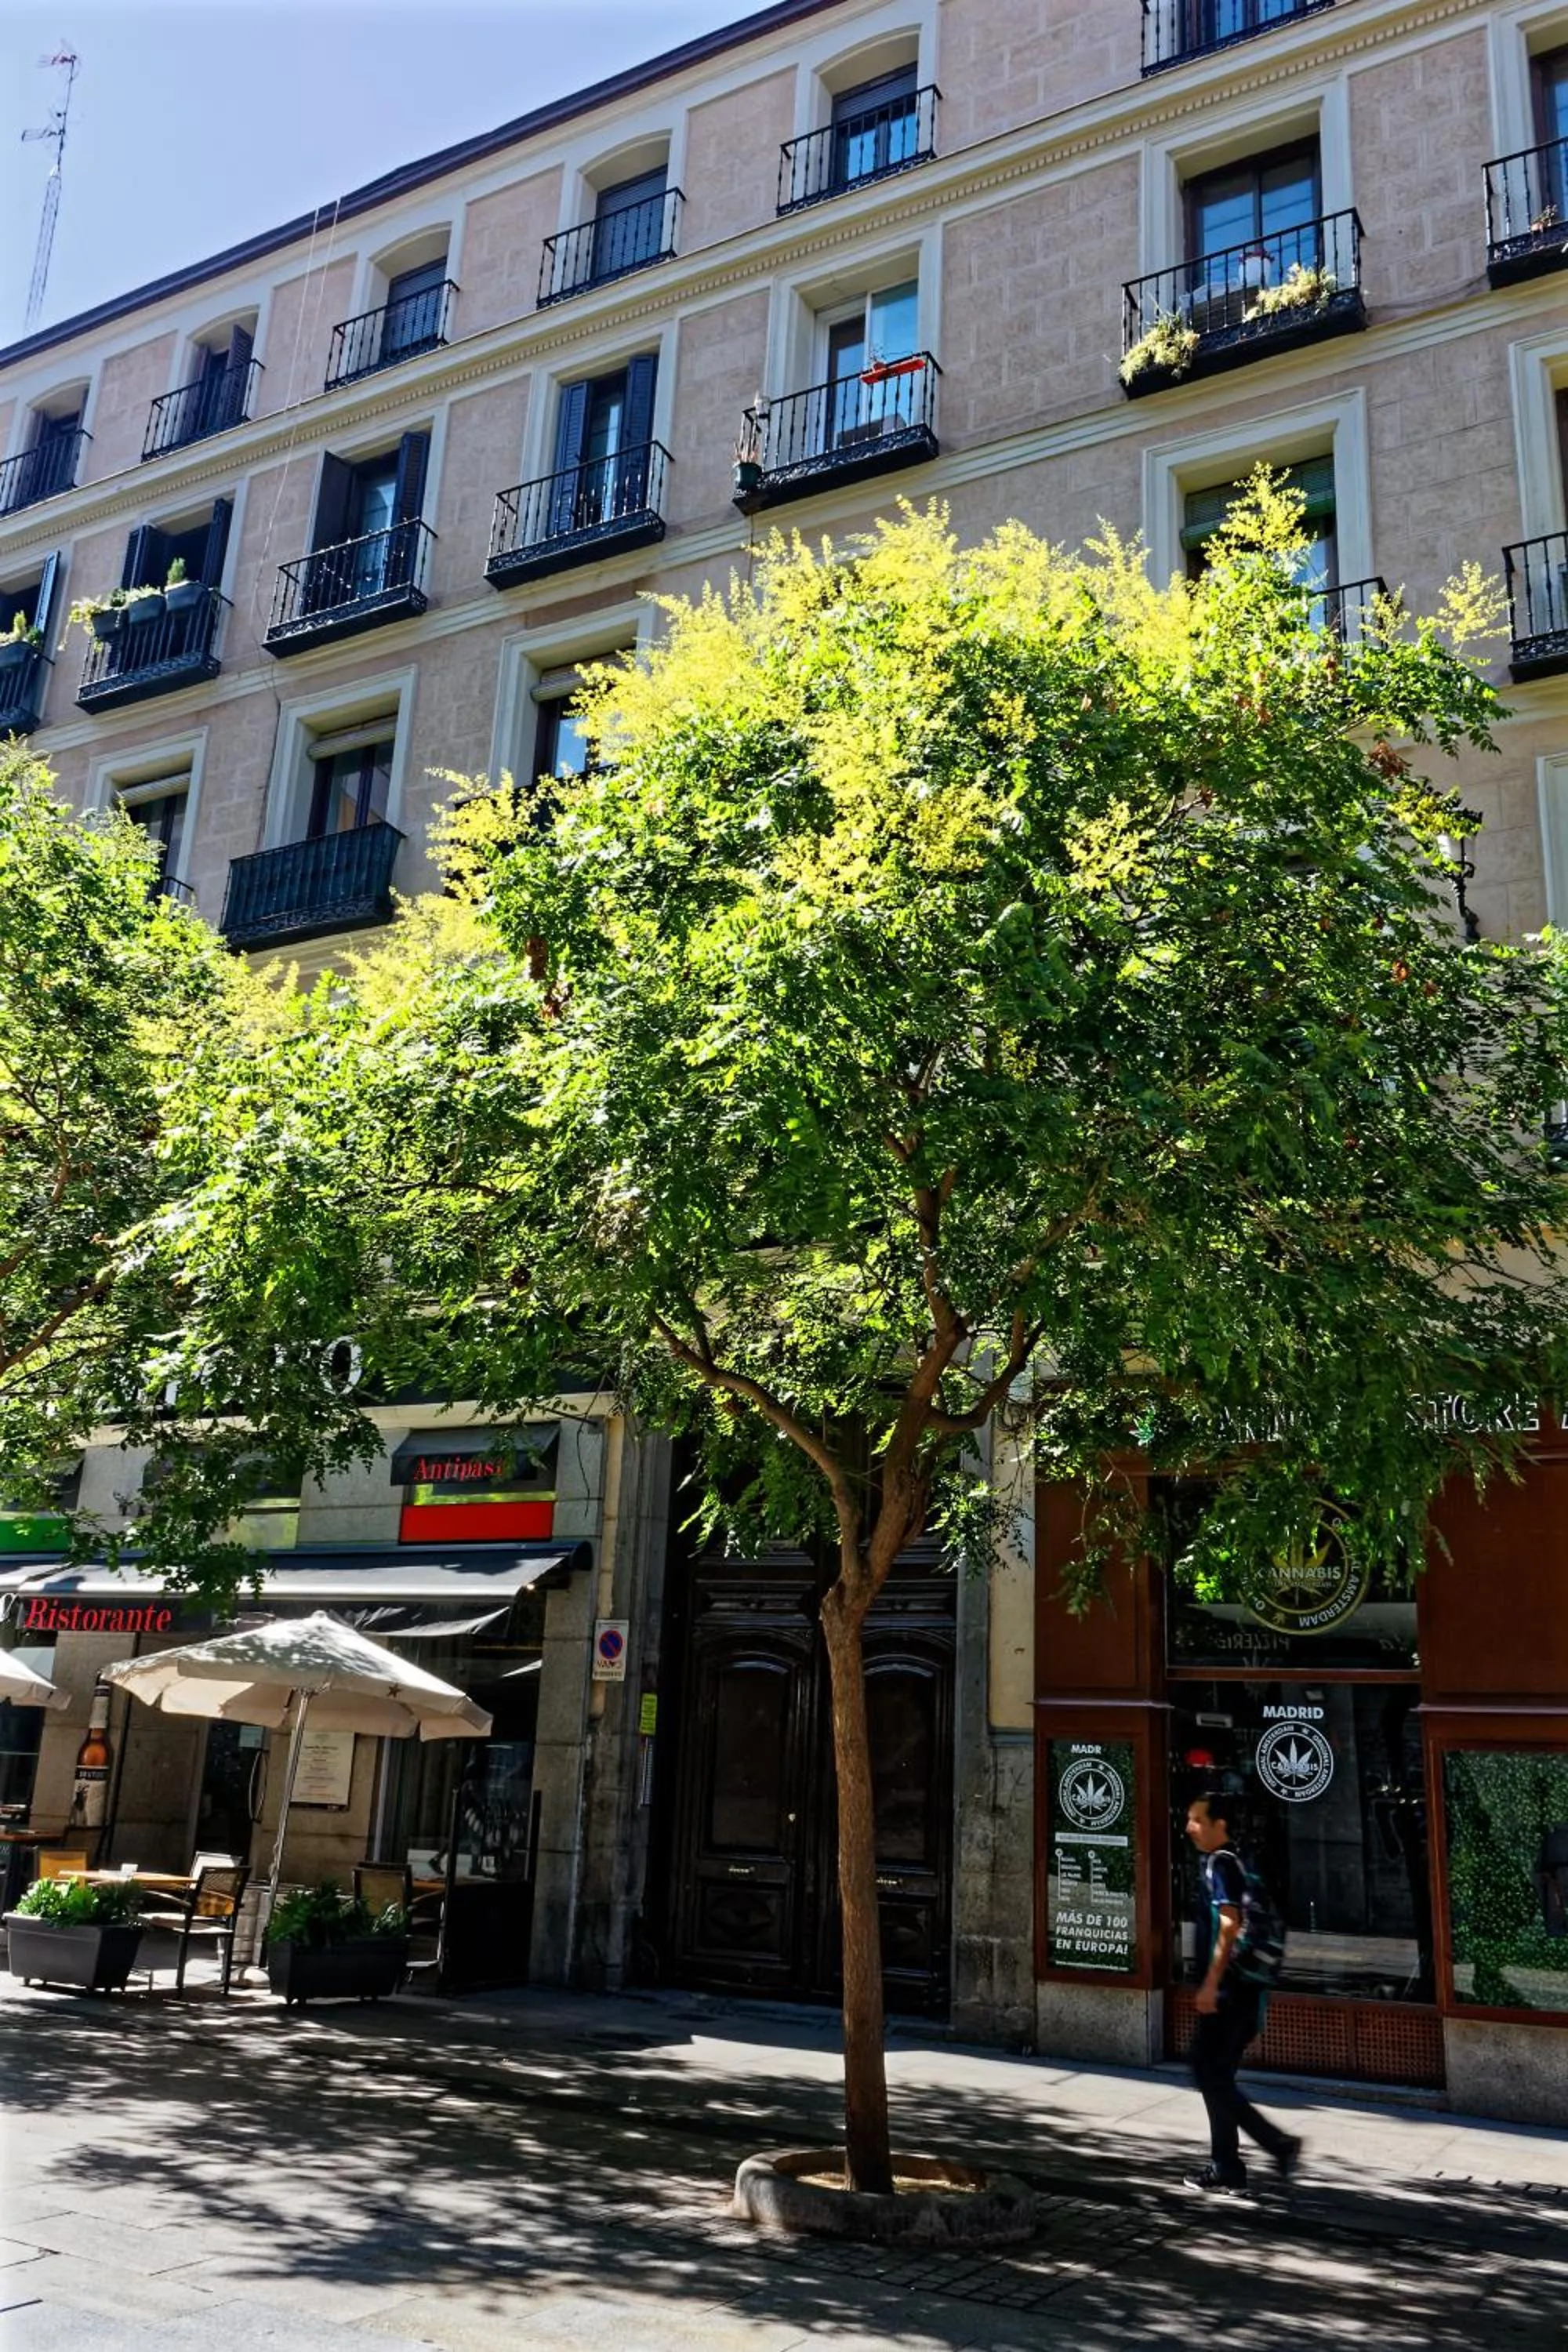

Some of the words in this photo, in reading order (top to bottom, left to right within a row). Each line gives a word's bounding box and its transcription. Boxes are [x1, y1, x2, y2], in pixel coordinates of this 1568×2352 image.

[1298, 1574, 1360, 1628] AMSTERDAM
[25, 1597, 172, 1632] Ristorante
[1262, 1705, 1324, 1719] MADRID
[1070, 1744, 1102, 1755] MADR
[1056, 1910, 1083, 1925] MÁS
[1086, 1914, 1102, 1926] DE
[1107, 1915, 1128, 1928] 100
[1055, 1925, 1129, 1940] FRANQUICIAS
[1055, 1939, 1072, 1950] EN
[1075, 1940, 1129, 1955] EUROPA!
